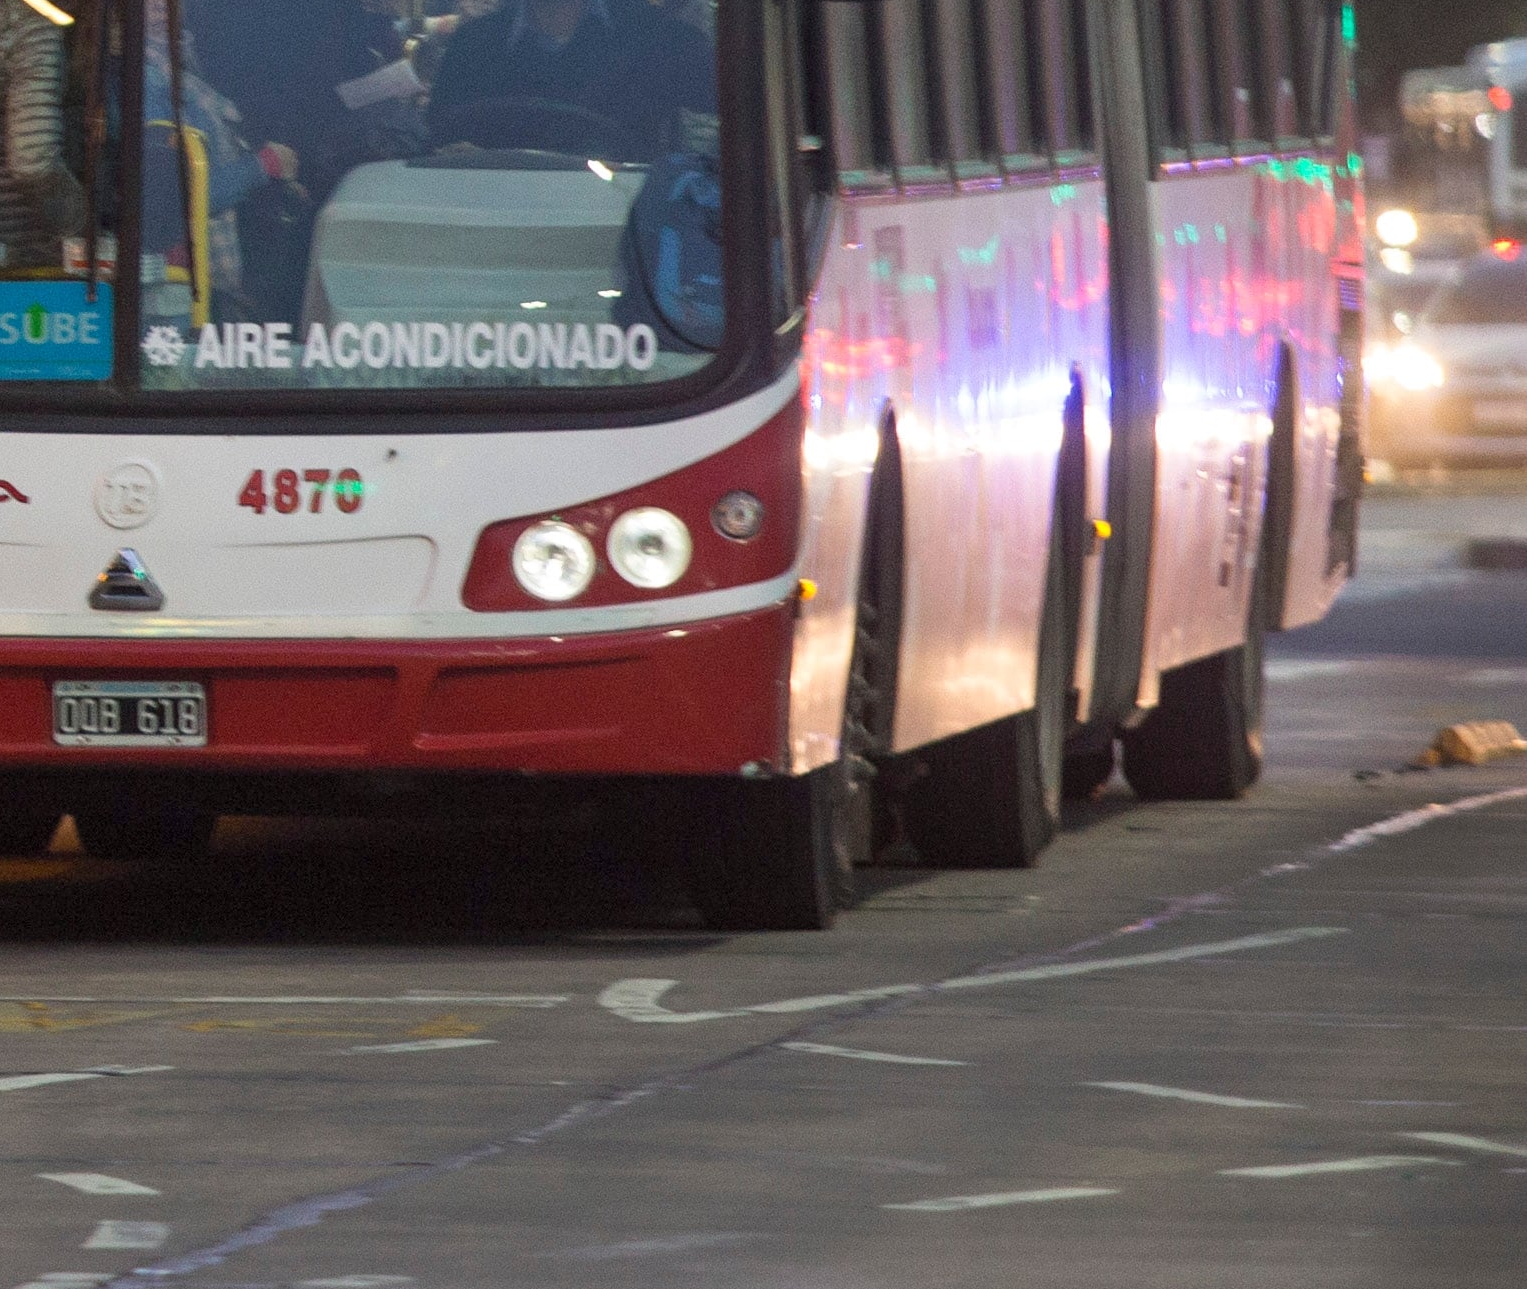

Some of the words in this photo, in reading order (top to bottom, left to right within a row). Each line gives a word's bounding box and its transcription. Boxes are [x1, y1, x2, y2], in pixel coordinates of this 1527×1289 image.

[196, 323, 294, 370] AIRE
[303, 321, 659, 372] ACONDICIONADO
[238, 468, 365, 514] 4870
[137, 698, 199, 735] 618
